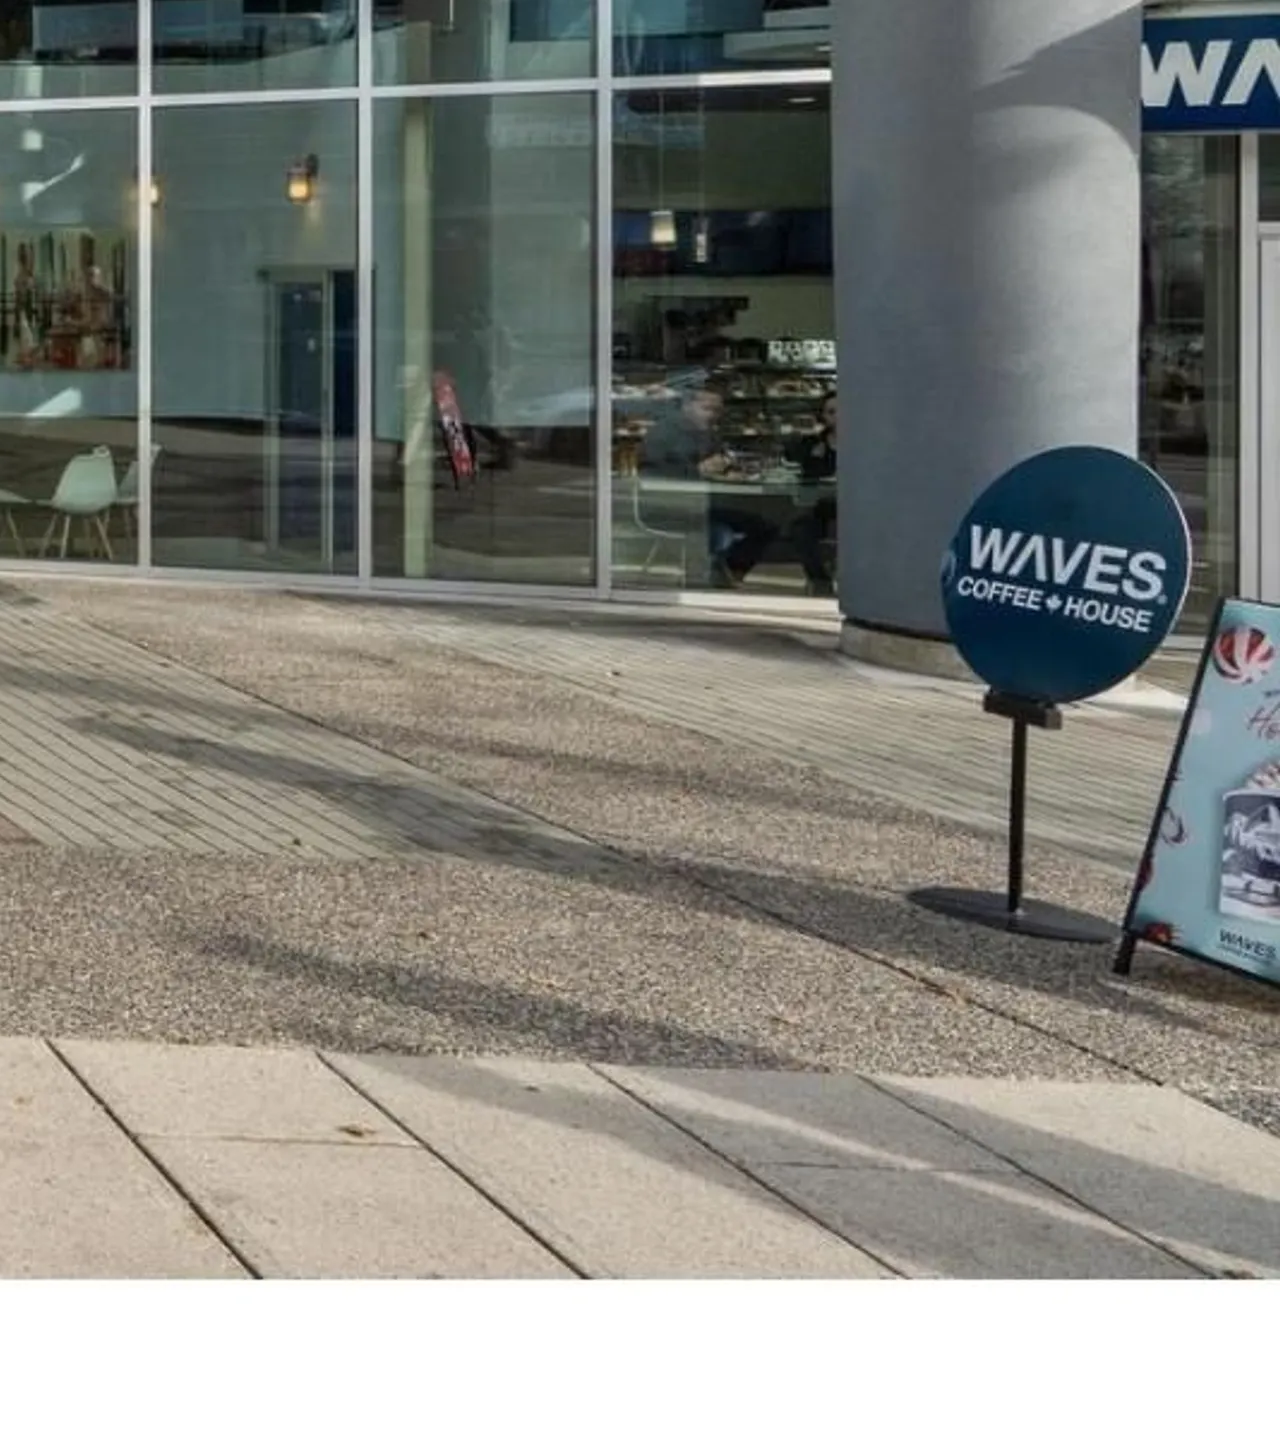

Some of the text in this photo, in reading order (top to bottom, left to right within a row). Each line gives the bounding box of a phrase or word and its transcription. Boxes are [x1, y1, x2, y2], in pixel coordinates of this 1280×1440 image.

[970, 524, 1167, 602] WAVES
[957, 575, 1154, 633] COFFEE HOUSE
[1218, 927, 1277, 960] WAVES
